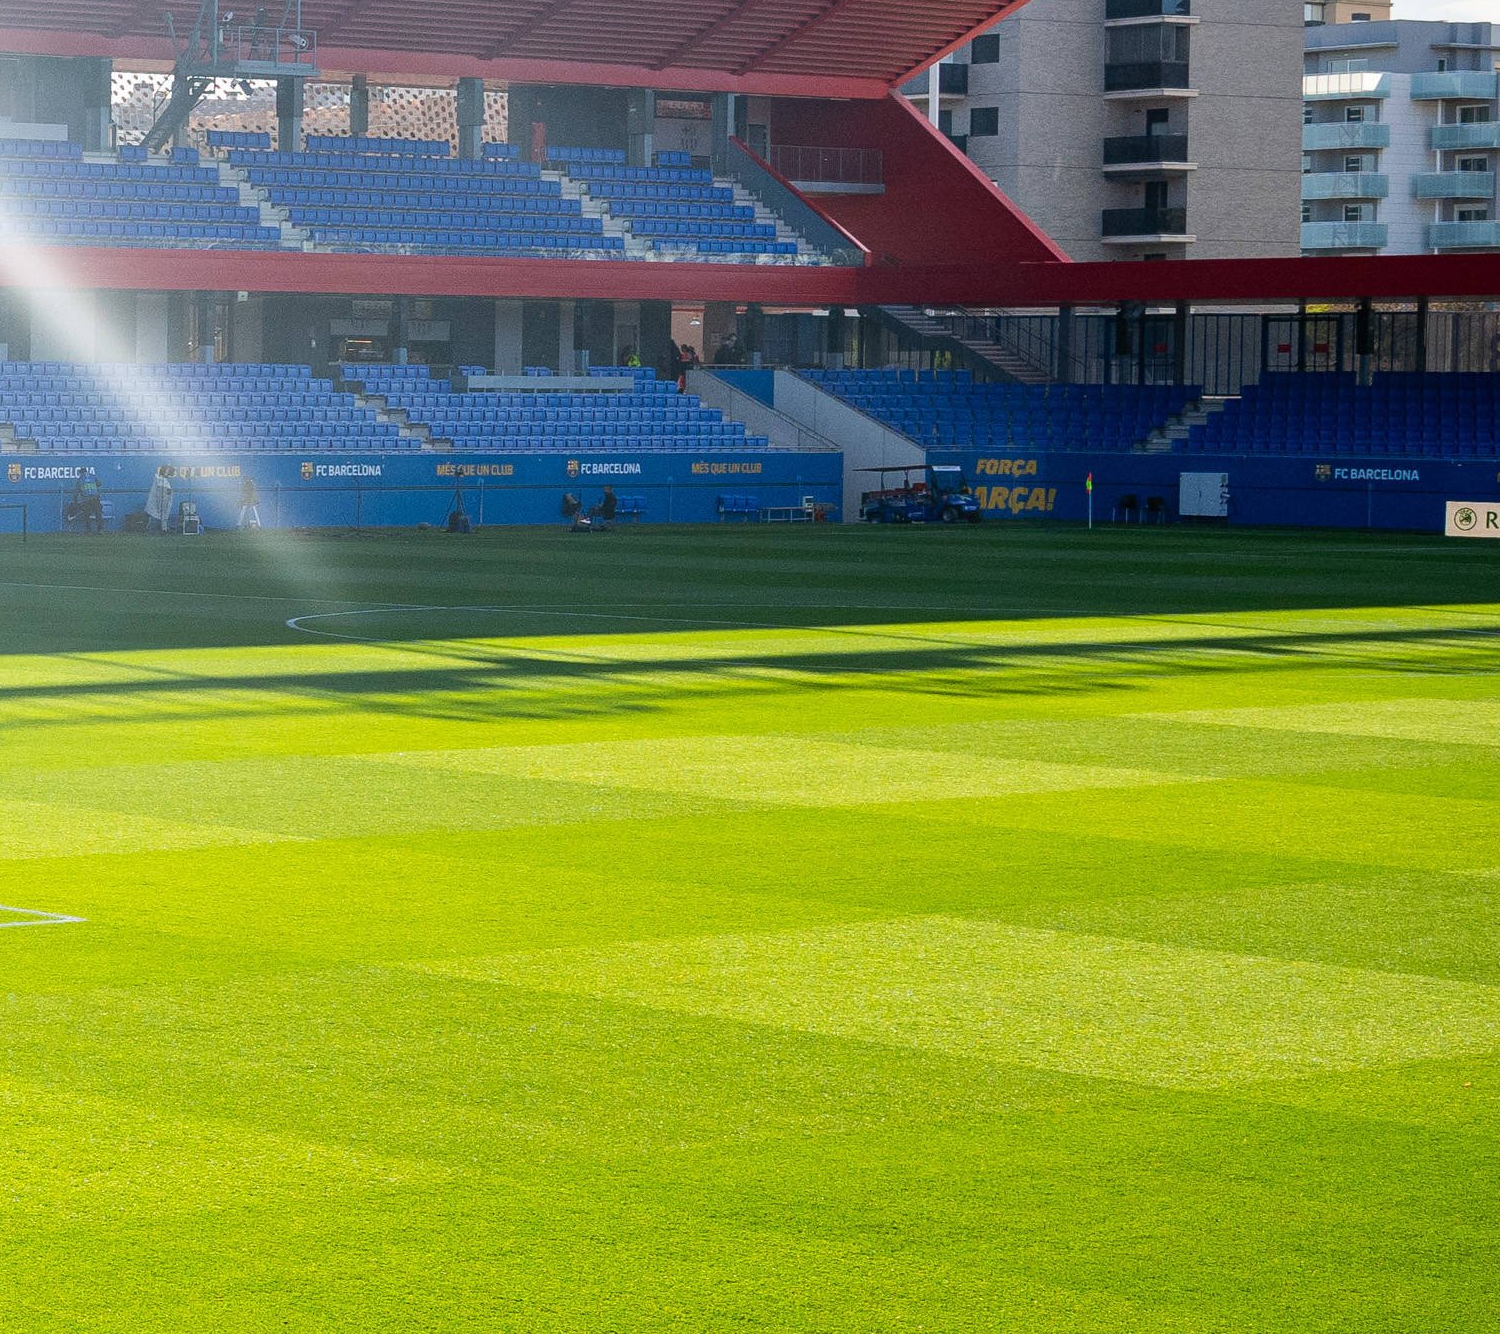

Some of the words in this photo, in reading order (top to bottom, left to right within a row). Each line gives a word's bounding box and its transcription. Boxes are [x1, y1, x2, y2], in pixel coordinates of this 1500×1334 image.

[24, 467, 37, 479] FC
[316, 464, 327, 476] FC
[328, 464, 382, 476] BARCELONA
[580, 463, 591, 474] FC
[592, 463, 641, 474] BARCELONA
[976, 458, 1038, 478] FORÇA
[1334, 468, 1349, 480] FC
[1350, 468, 1420, 481] BARCELONA
[1486, 511, 1500, 529] R
